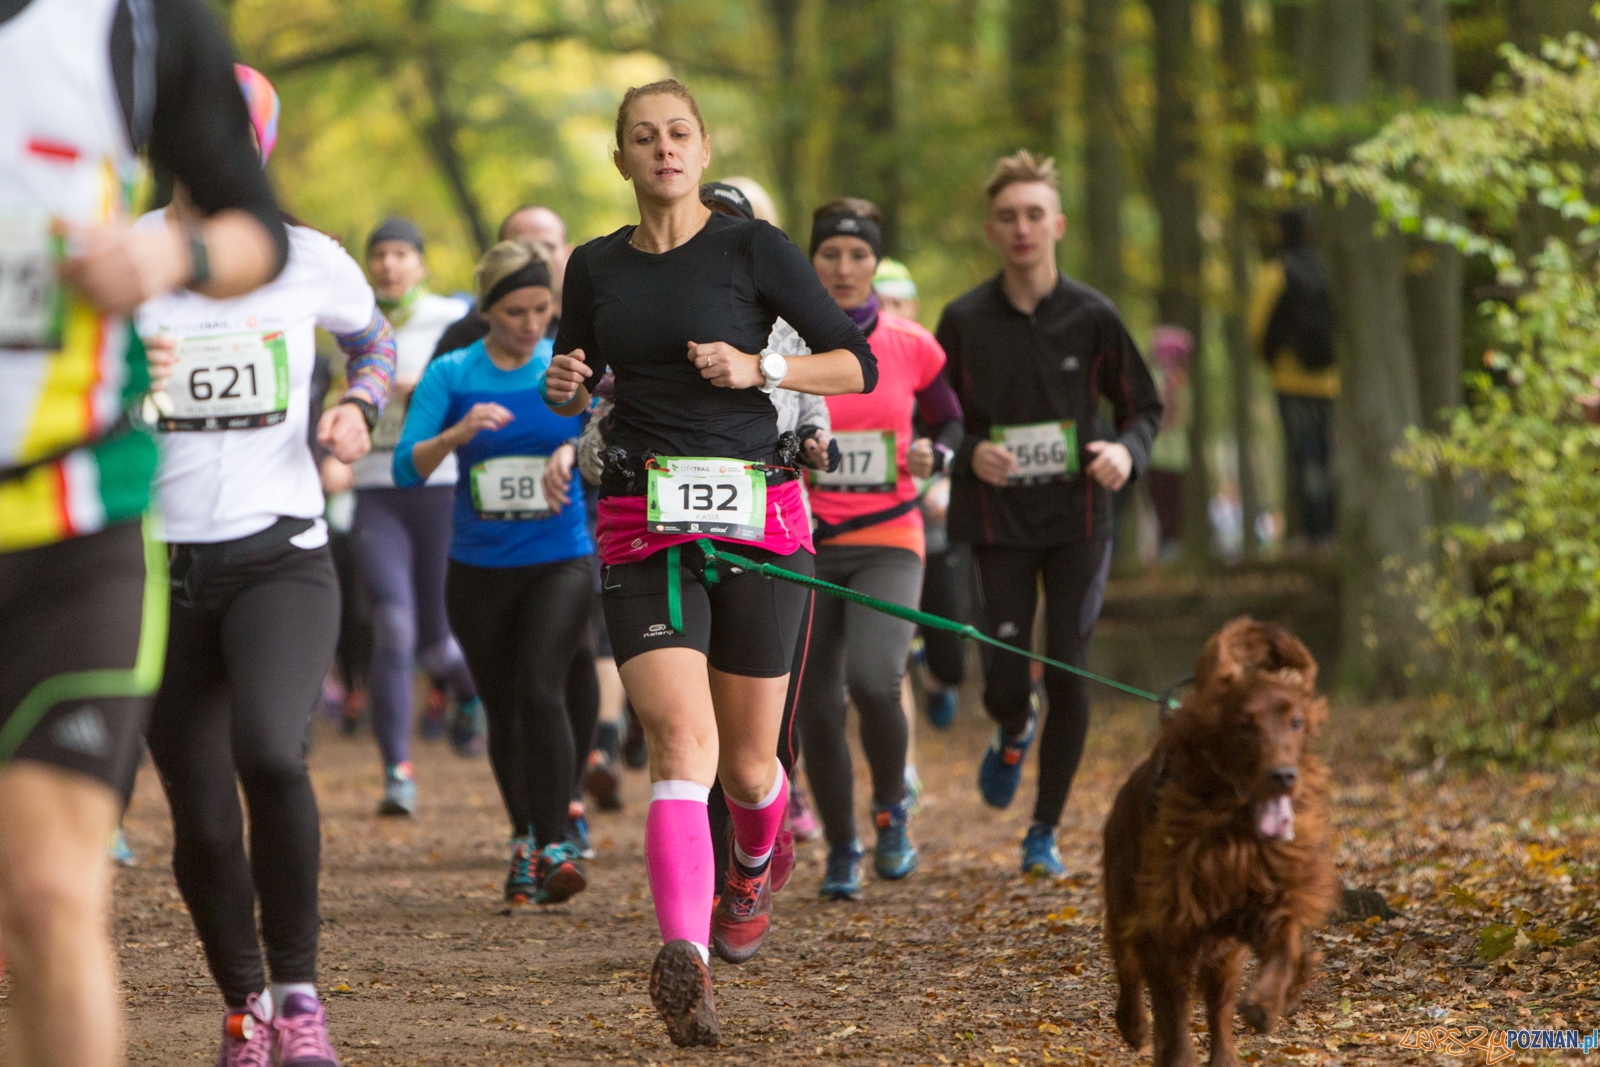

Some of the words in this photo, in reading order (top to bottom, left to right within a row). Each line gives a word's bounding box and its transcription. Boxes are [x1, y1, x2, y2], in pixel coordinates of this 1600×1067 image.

[189, 363, 257, 401] 621
[1007, 439, 1065, 467] 566
[500, 476, 534, 500] 58
[678, 483, 738, 511] 132
[643, 629, 674, 638] Kalenji
